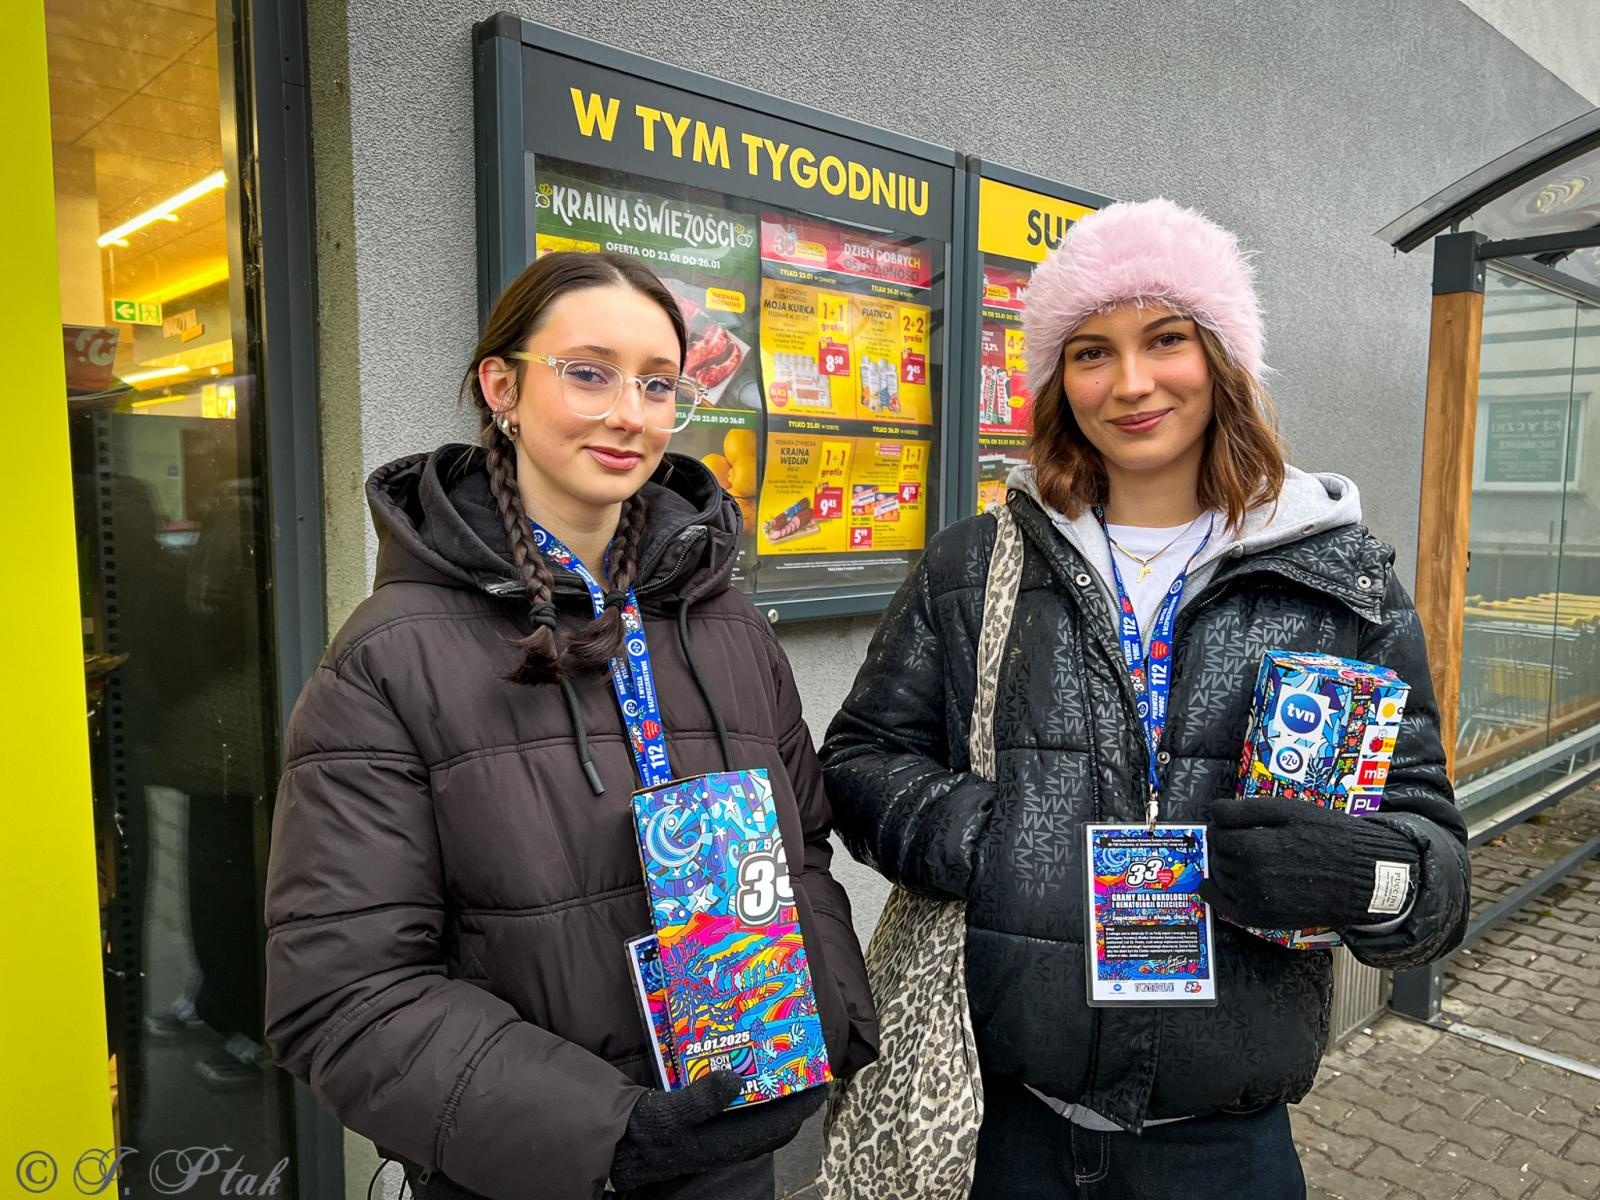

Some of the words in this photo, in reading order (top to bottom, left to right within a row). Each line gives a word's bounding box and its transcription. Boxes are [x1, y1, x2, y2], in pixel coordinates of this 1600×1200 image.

[570, 87, 621, 142] W
[635, 104, 731, 170] TYM
[741, 133, 930, 217] TYGODNIU
[552, 185, 630, 235] KRAINA
[633, 199, 735, 247] ŚWIEŻOŚCI
[606, 242, 639, 256] OFERTA
[641, 248, 656, 258] OD
[657, 251, 680, 263] 23.01
[682, 255, 697, 265] DO
[699, 257, 721, 269] 26.01
[844, 242, 874, 260] DZIEŃ
[876, 249, 921, 270] DOBRYCH
[780, 268, 798, 277] TYLKO
[764, 299, 787, 311] MOJA
[788, 303, 815, 315] KURKA
[691, 414, 701, 422] OD
[702, 415, 718, 423] 23.01
[719, 416, 729, 424] DO
[730, 417, 745, 425] 26.01
[788, 420, 806, 428] TYLKO
[780, 447, 810, 456] KRAINA
[821, 468, 843, 478] gratis
[621, 612, 639, 629] 33
[1123, 616, 1137, 636] 112
[1130, 675, 1144, 691] 33
[1151, 663, 1168, 686] 112
[1287, 702, 1315, 724] tvn
[647, 743, 666, 770] 112
[740, 840, 772, 854] 2025
[1127, 857, 1164, 887] 33
[1111, 893, 1136, 901] GRAMY
[1137, 893, 1150, 901] DLA
[1151, 893, 1188, 901] ONKOLOGII
[1388, 872, 1401, 907] PUCCINI
[685, 1031, 751, 1056] 26.01.2025
